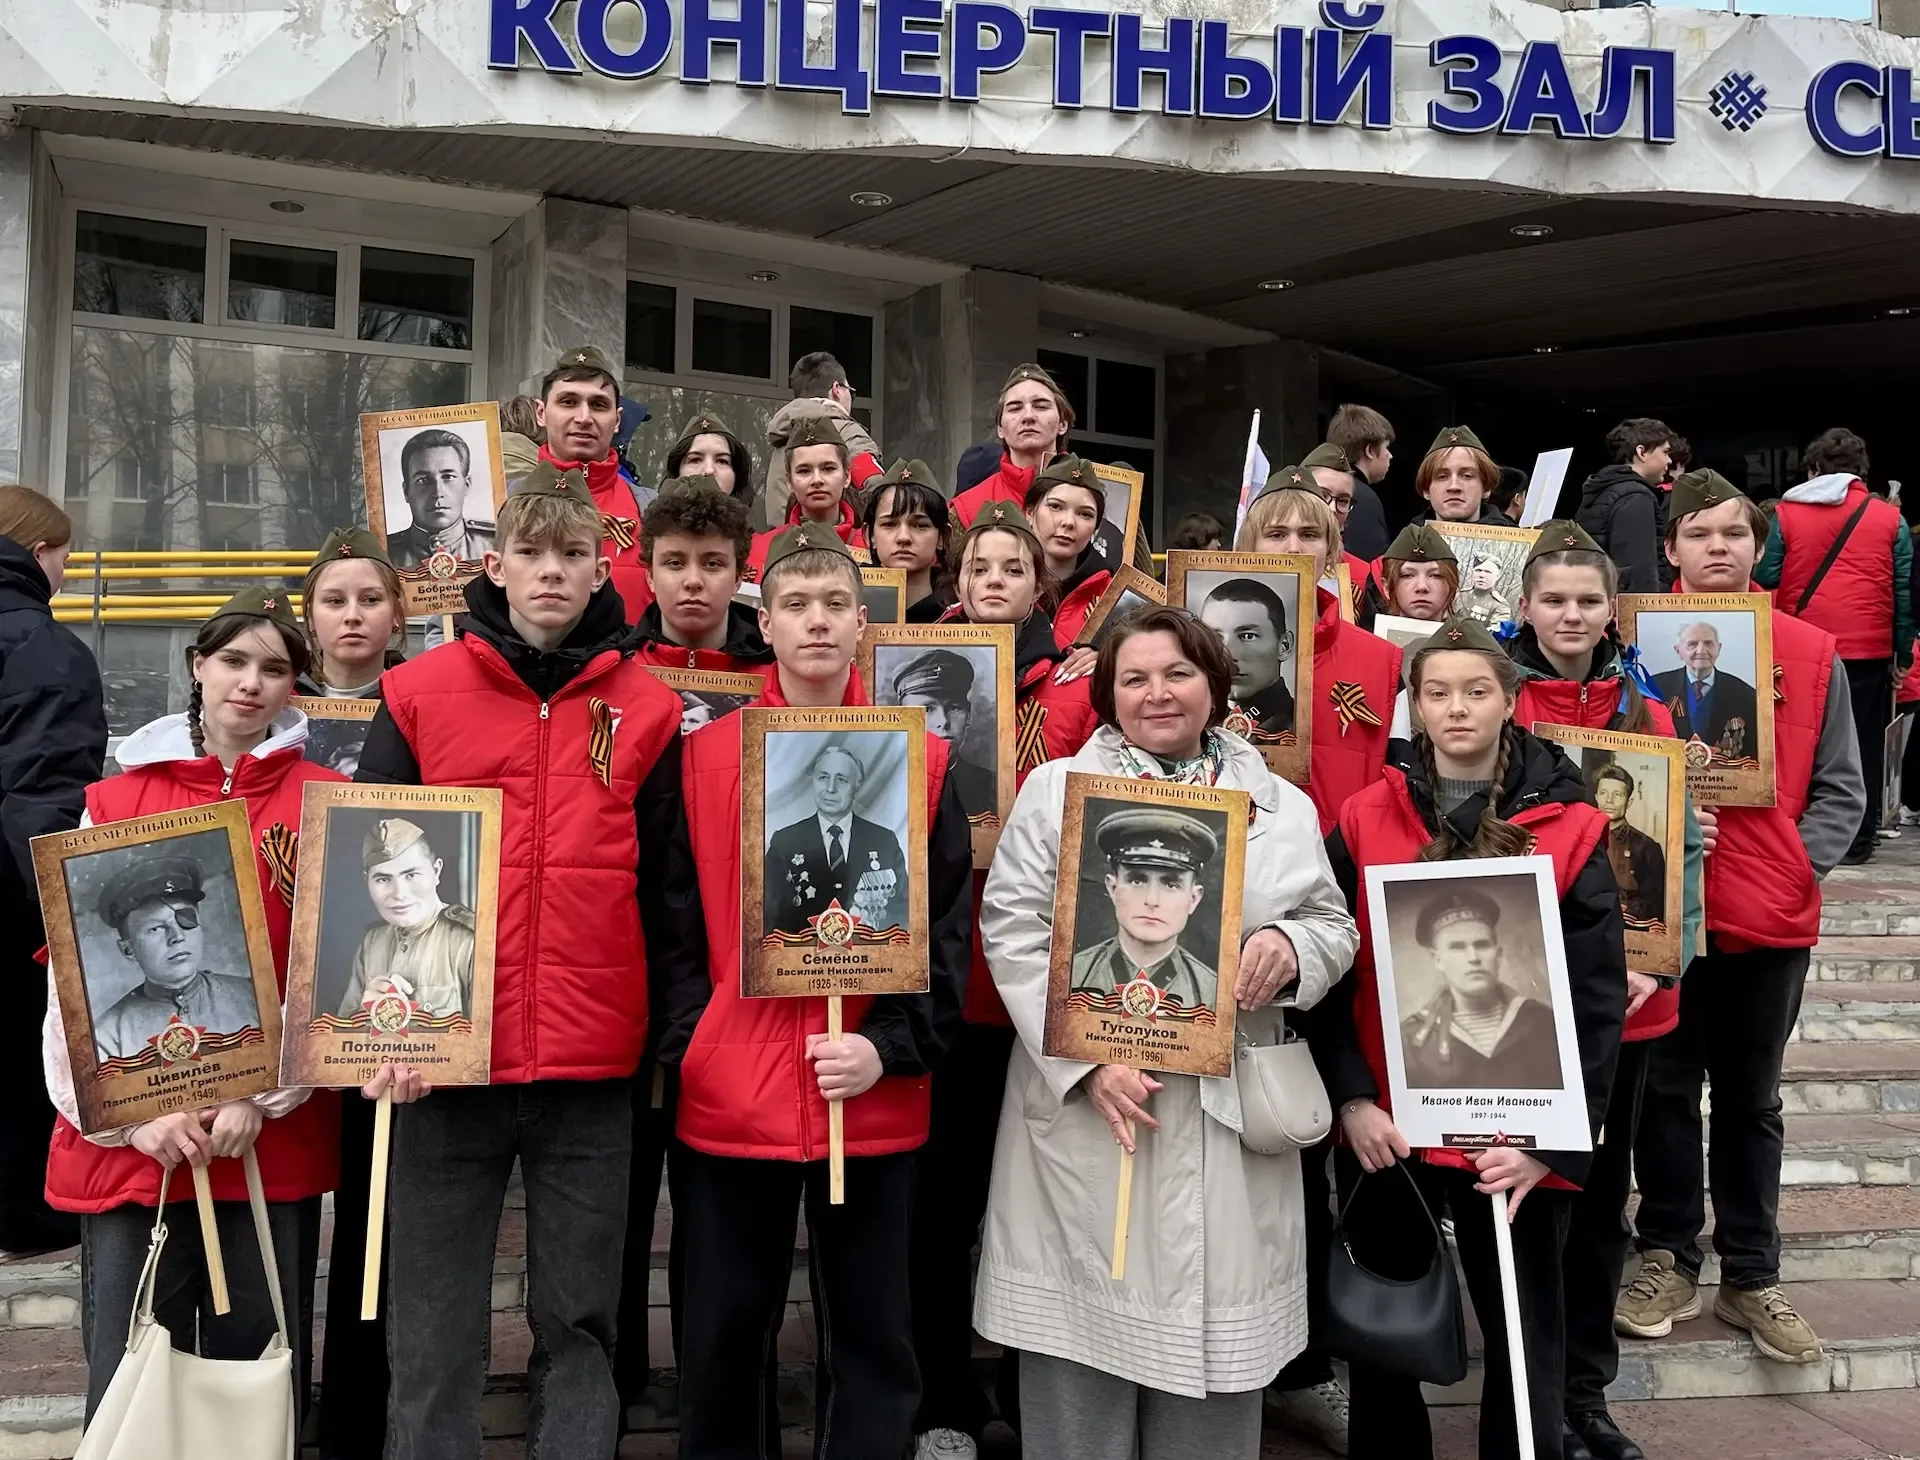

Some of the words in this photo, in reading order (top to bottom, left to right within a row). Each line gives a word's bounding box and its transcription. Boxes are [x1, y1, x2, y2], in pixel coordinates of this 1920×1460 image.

[488, 0, 1395, 131] КОНЦЕРТНЫЙ
[1428, 34, 1677, 145] ЗАЛ
[1267, 559, 1294, 567] ПОЛК
[418, 583, 466, 595] Бобрецо
[1720, 597, 1748, 605] ПОЛК
[963, 630, 992, 638] ПОЛК
[725, 678, 755, 688] ПОЛК
[768, 713, 865, 724] БЕССМЕРТНЫЙ
[867, 713, 901, 724] ПОЛК
[1636, 740, 1664, 750] ПОЛК
[333, 788, 436, 804] БЕССМЕРТНЫЙ
[439, 792, 477, 804] ПОЛК
[1089, 779, 1186, 799] БЕССМЕРТНЫЙ
[1187, 790, 1223, 804] ПОЛК
[64, 817, 175, 849] БЕССМЕРТНЫЙ
[178, 810, 218, 827] ПОЛК
[802, 952, 869, 965] Семёнов
[776, 966, 824, 977] Василий
[827, 965, 893, 976] Николаевич
[839, 977, 862, 991] 1995)
[1100, 1019, 1178, 1040] Туголуков
[341, 1040, 436, 1054] Потолицын
[1085, 1032, 1133, 1046] Николай
[1136, 1038, 1190, 1052] Павлович
[324, 1054, 377, 1064] Василий
[381, 1055, 451, 1064] Степанович
[1109, 1047, 1132, 1061] (1913
[1140, 1050, 1163, 1064] 1996)
[147, 1061, 222, 1087] Цивилёв
[102, 1084, 187, 1110] Пантелеймон
[190, 1065, 267, 1089] Григорьевич
[157, 1094, 184, 1113] (1910
[191, 1086, 219, 1104] 1949)
[1421, 1094, 1462, 1106] Иванов
[1465, 1095, 1493, 1106] Иван
[1496, 1096, 1552, 1107] Иванович
[1470, 1112, 1507, 1120] 1897-1944
